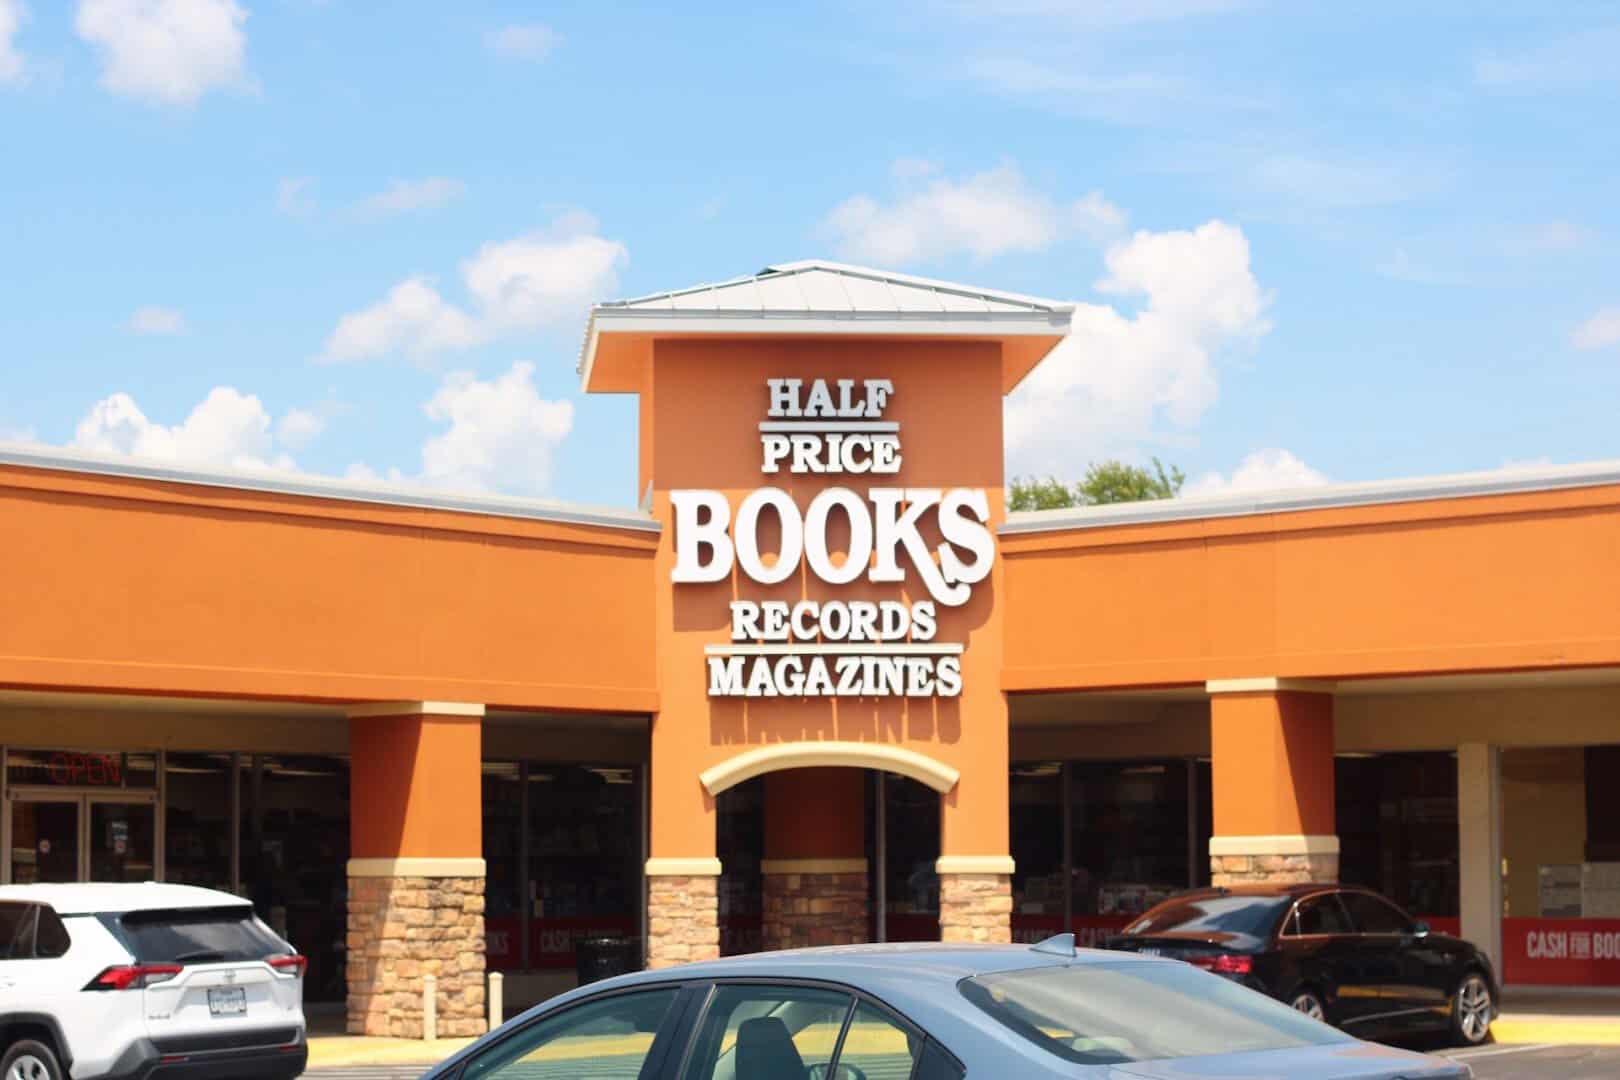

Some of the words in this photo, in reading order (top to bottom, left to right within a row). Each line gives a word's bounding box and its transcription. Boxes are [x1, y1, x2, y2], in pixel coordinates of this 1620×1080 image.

[767, 378, 894, 417] HALF
[761, 433, 902, 473] PRICE
[670, 487, 995, 606] BOOKS
[730, 601, 937, 641] RECORDS
[708, 656, 962, 697] MAGAZINES
[50, 752, 121, 785] OPEN
[1527, 931, 1567, 958] CASH
